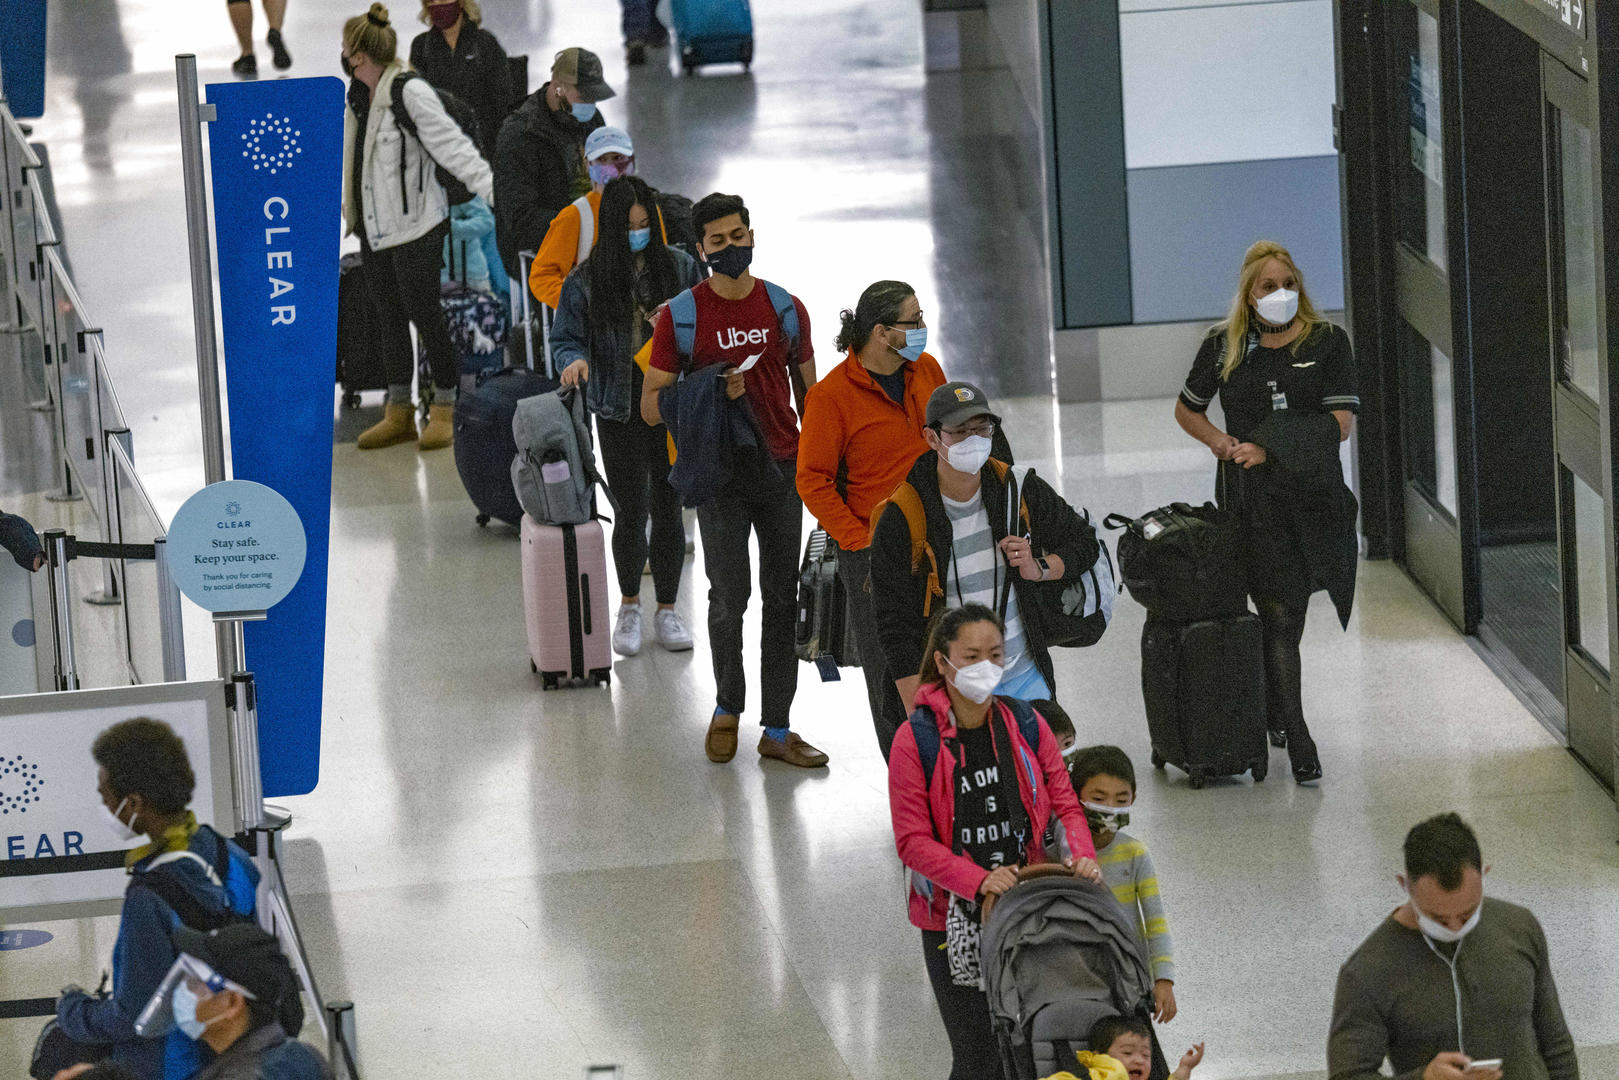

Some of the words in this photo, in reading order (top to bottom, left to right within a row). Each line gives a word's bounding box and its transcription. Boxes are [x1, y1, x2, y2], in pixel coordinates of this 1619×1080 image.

[263, 196, 296, 326] CLEAR
[717, 327, 769, 349] Uber
[217, 521, 251, 529] CLEAR
[212, 539, 234, 550] Stay
[236, 537, 260, 547] safe.
[194, 555, 220, 565] Keep
[222, 555, 245, 565] your
[248, 552, 279, 564] space.
[203, 573, 224, 581] Thank
[251, 571, 272, 579] caring
[235, 581, 272, 590] distancing.
[7, 831, 85, 860] EAR
